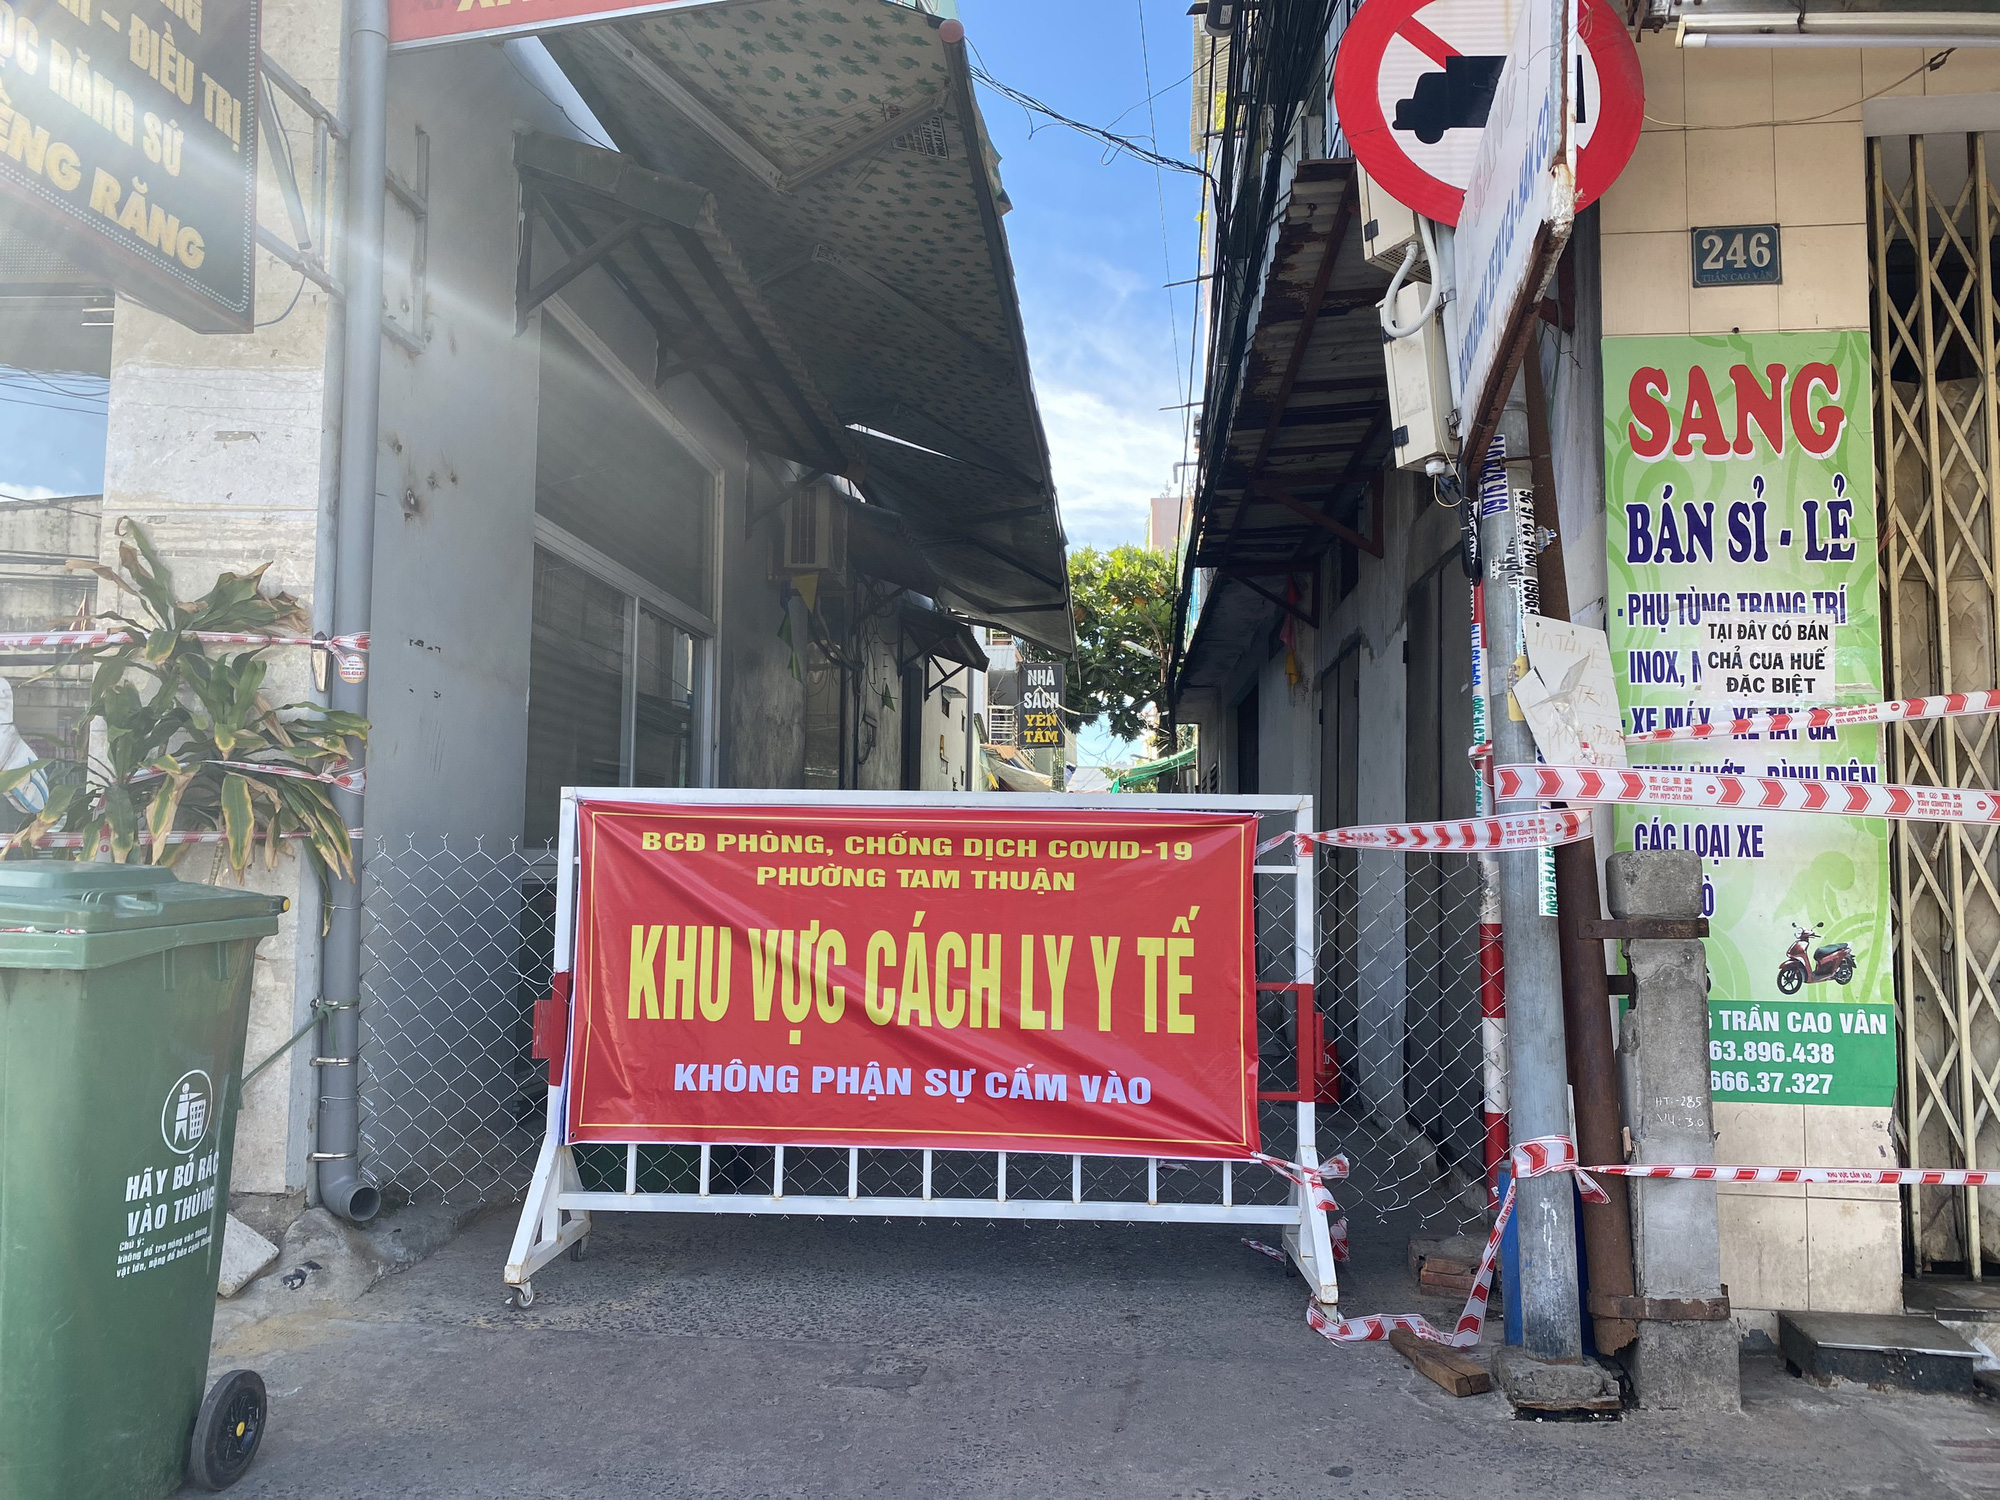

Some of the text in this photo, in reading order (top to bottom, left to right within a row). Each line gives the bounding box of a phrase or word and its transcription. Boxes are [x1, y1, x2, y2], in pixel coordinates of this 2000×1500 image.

[49, 38, 134, 147] RĂNG
[128, 12, 195, 105] ĐIỀU
[202, 72, 242, 153] TRỊ
[88, 166, 205, 269] RĂNG
[1702, 232, 1771, 270] 246
[1628, 362, 1847, 461] SANG
[1626, 484, 1714, 563] BÁN
[1728, 476, 1769, 563] SỈ
[1803, 474, 1856, 562] LẺ
[1628, 584, 1848, 633] PHỤ TÙNG TRANG TRÍ
[1708, 620, 1829, 643] TẠI ĐÂY CÓ BÁN
[1027, 666, 1055, 686] NHÀ
[1629, 650, 1685, 687] INOX,
[1708, 646, 1743, 669] CHẢ
[1749, 652, 1784, 670] CUA
[1790, 646, 1826, 670] HUẾ
[1726, 674, 1816, 697] ĐẶC BIỆT
[1023, 728, 1059, 743] TÂM
[1024, 712, 1057, 727] YÊN
[1633, 707, 1657, 734] XE
[1665, 701, 1711, 740] MÁY
[1733, 707, 1758, 740] XE
[641, 830, 1193, 861] BCĐ PHÒNG, CHỐNG DỊCH COVID-19
[1635, 818, 1764, 865] CÁC LOẠI XE
[757, 863, 1075, 895] PHƯỜNG TAM THUẬN
[627, 905, 1200, 1045] KHU VỰC CÁCH LY Y TẾ
[1719, 1004, 1780, 1032] TRẦN
[1787, 1013, 1833, 1034] CAO
[1839, 1009, 1887, 1035] VÂN
[1709, 1040, 1835, 1064] 63.896.438
[674, 1058, 1151, 1105] KHÔNG PHẬN SỰ CẤM VÀO
[1710, 1070, 1834, 1095] 666.37.327
[125, 1149, 220, 1202] HÃY BỎ RÁC
[127, 1186, 215, 1237] VÀO THÙNG
[117, 1251, 141, 1264] không
[119, 1239, 134, 1252] Chú
